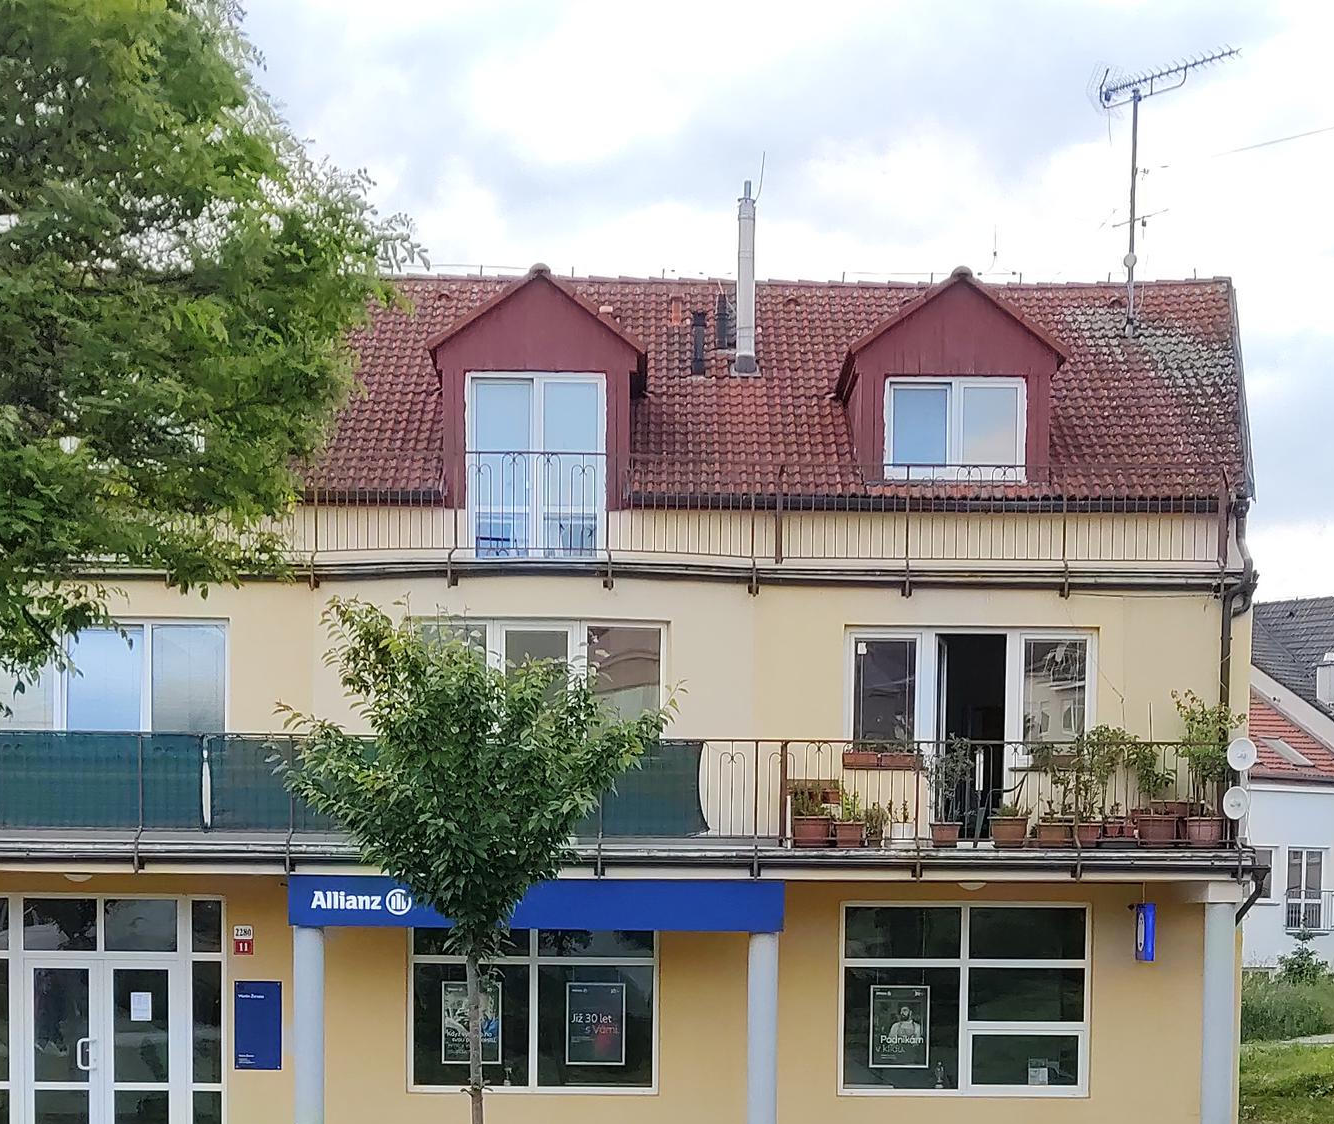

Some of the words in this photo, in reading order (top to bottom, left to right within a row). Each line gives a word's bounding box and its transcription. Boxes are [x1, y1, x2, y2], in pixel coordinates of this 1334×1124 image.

[310, 890, 382, 910] Allianz
[235, 928, 252, 937] 2280
[239, 942, 249, 952] 11
[585, 1013, 598, 1023] 30
[599, 1013, 612, 1024] let
[880, 1035, 924, 1044] Podnikám
